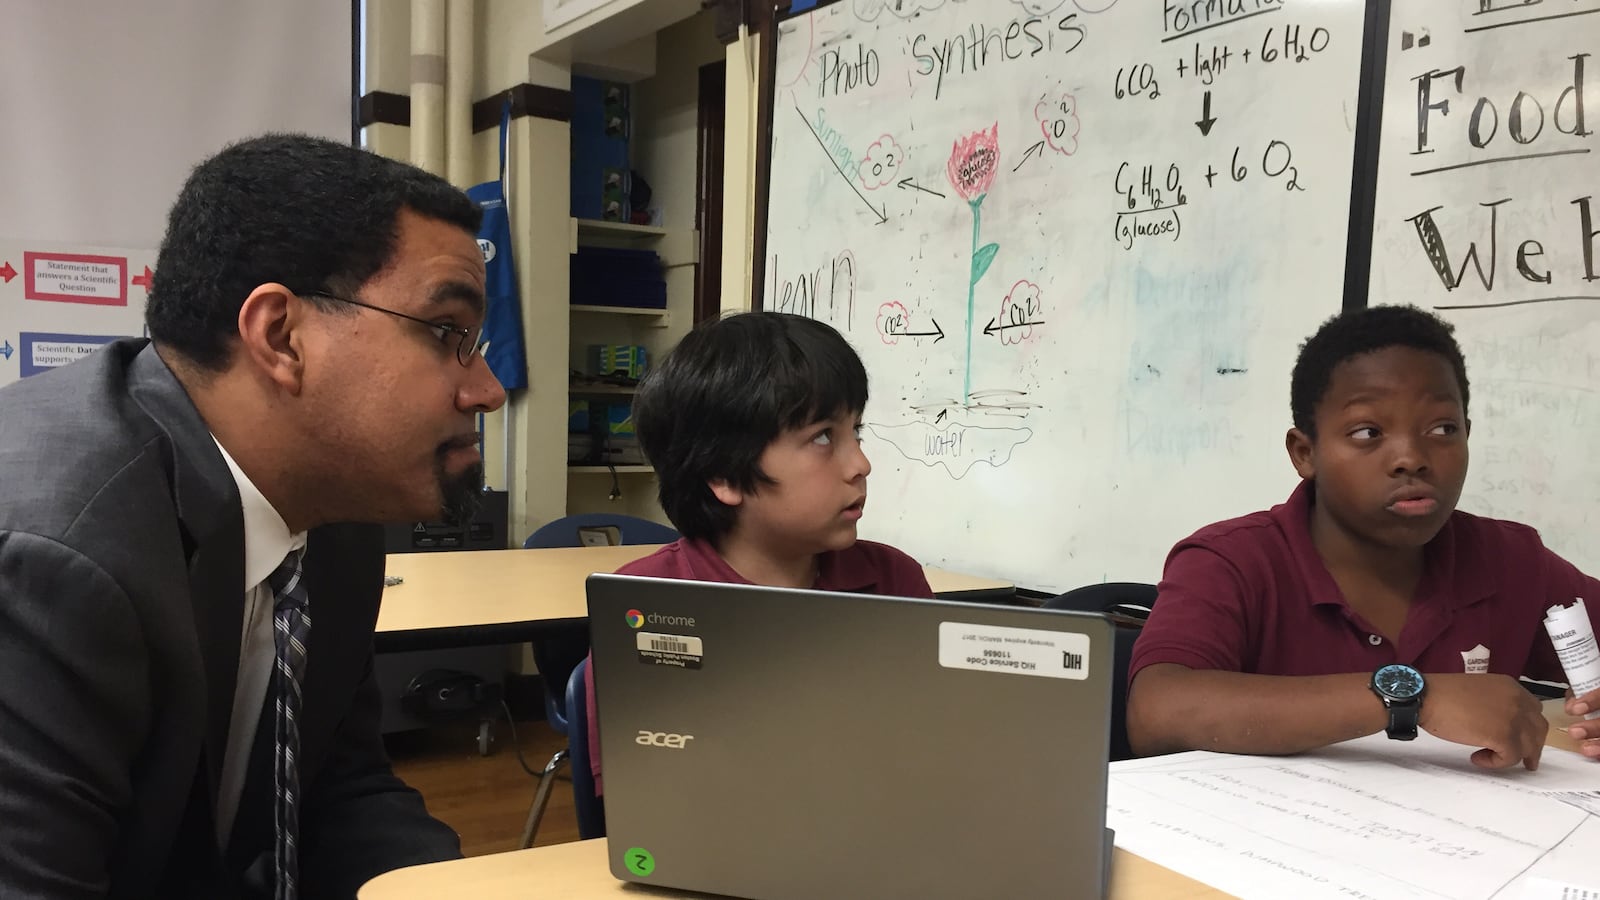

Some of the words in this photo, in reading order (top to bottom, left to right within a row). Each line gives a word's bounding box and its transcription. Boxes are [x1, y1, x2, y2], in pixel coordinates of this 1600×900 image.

[1161, 0, 1285, 32] Formu
[817, 43, 880, 98] Photo
[912, 13, 1087, 100] Synthesis
[1195, 43, 1233, 86] light
[1410, 53, 1594, 154] Food
[1114, 209, 1181, 251] (glucose)
[48, 261, 90, 273] Statement
[91, 265, 108, 274] that
[37, 272, 72, 281] answers
[81, 274, 118, 285] Scientific
[59, 282, 96, 293] Question
[37, 344, 74, 353] Scientific
[35, 355, 73, 364] supports
[924, 429, 966, 457] water
[647, 612, 696, 627] chrome
[966, 656, 987, 666] Code
[990, 658, 1019, 669] Service
[635, 730, 694, 749] acer
